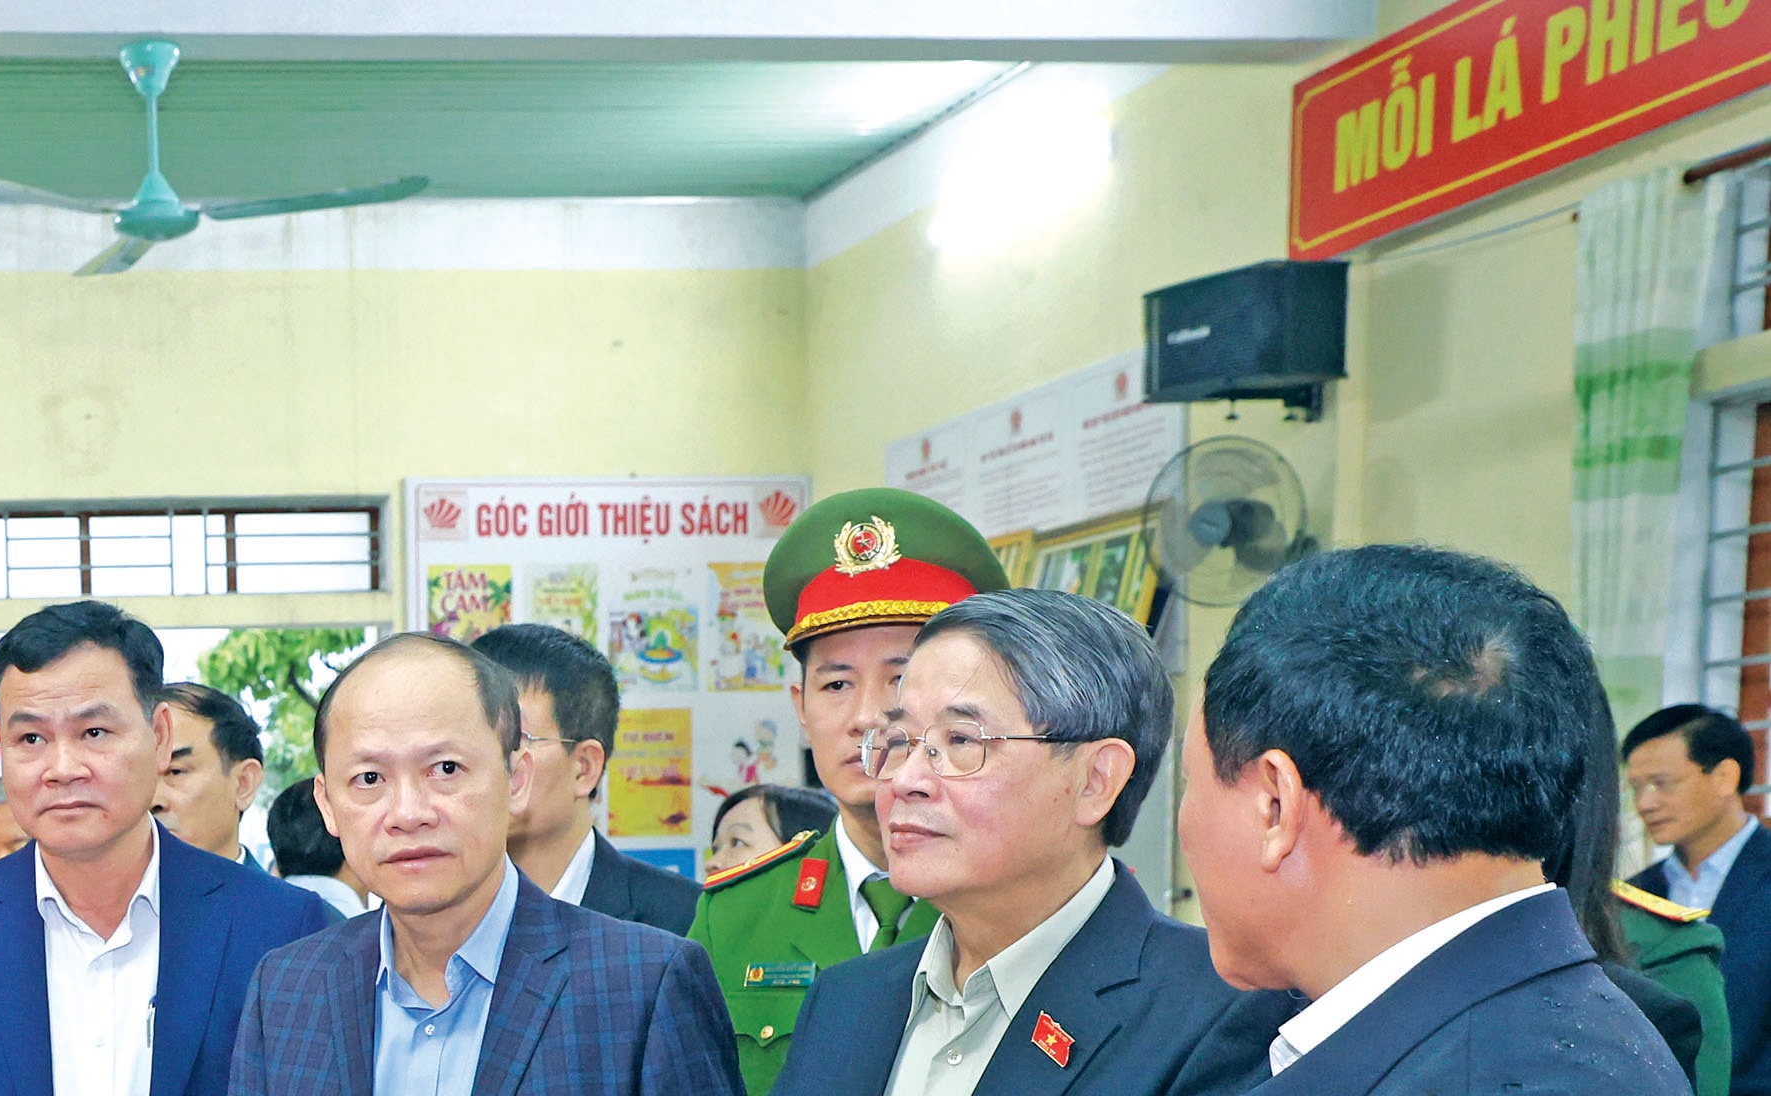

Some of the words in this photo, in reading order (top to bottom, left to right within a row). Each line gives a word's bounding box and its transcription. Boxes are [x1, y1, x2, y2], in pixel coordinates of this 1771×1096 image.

[1334, 54, 1436, 194] MỖI
[1451, 16, 1523, 143] LÁ
[477, 495, 528, 536] GÓC
[538, 493, 589, 536] GIỚI
[599, 496, 671, 545] THIỆU
[681, 495, 749, 536] SÁCH
